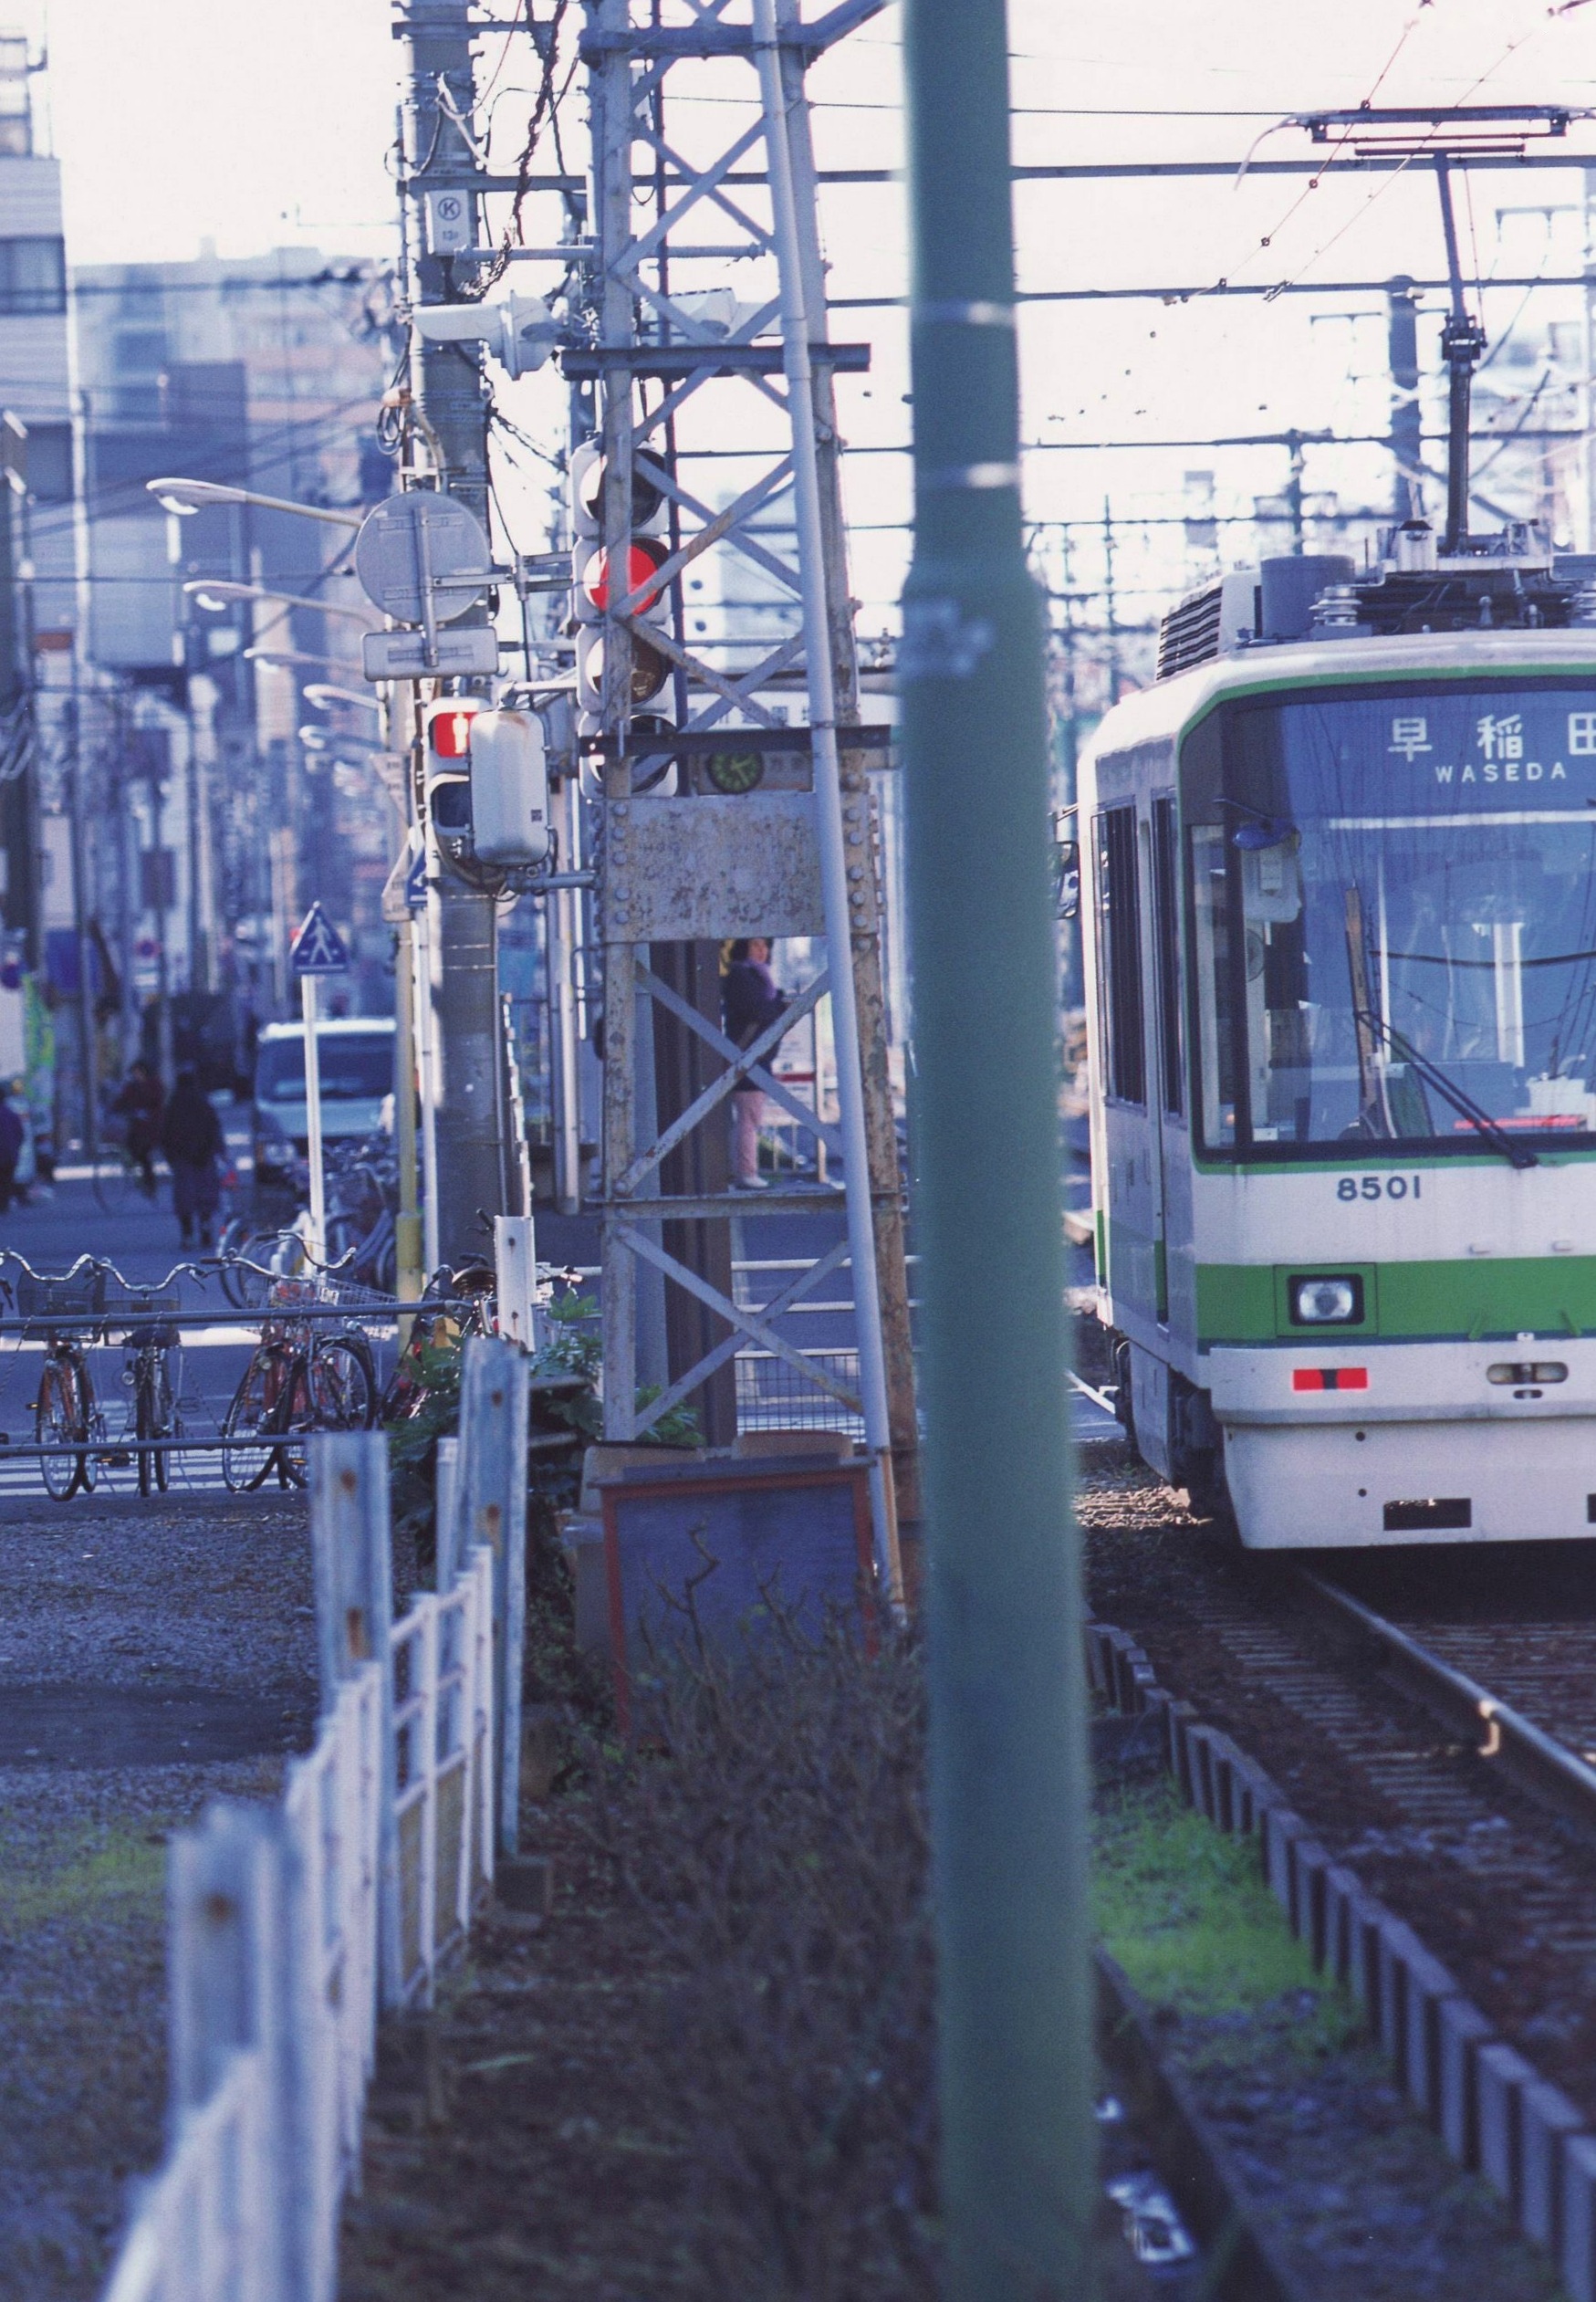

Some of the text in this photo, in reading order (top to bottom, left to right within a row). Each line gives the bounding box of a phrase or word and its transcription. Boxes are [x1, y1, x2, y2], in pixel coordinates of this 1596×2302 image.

[1387, 711, 1596, 763] 早稲田
[1434, 761, 1567, 783] WASEDA
[1337, 1175, 1421, 1202] 8501
